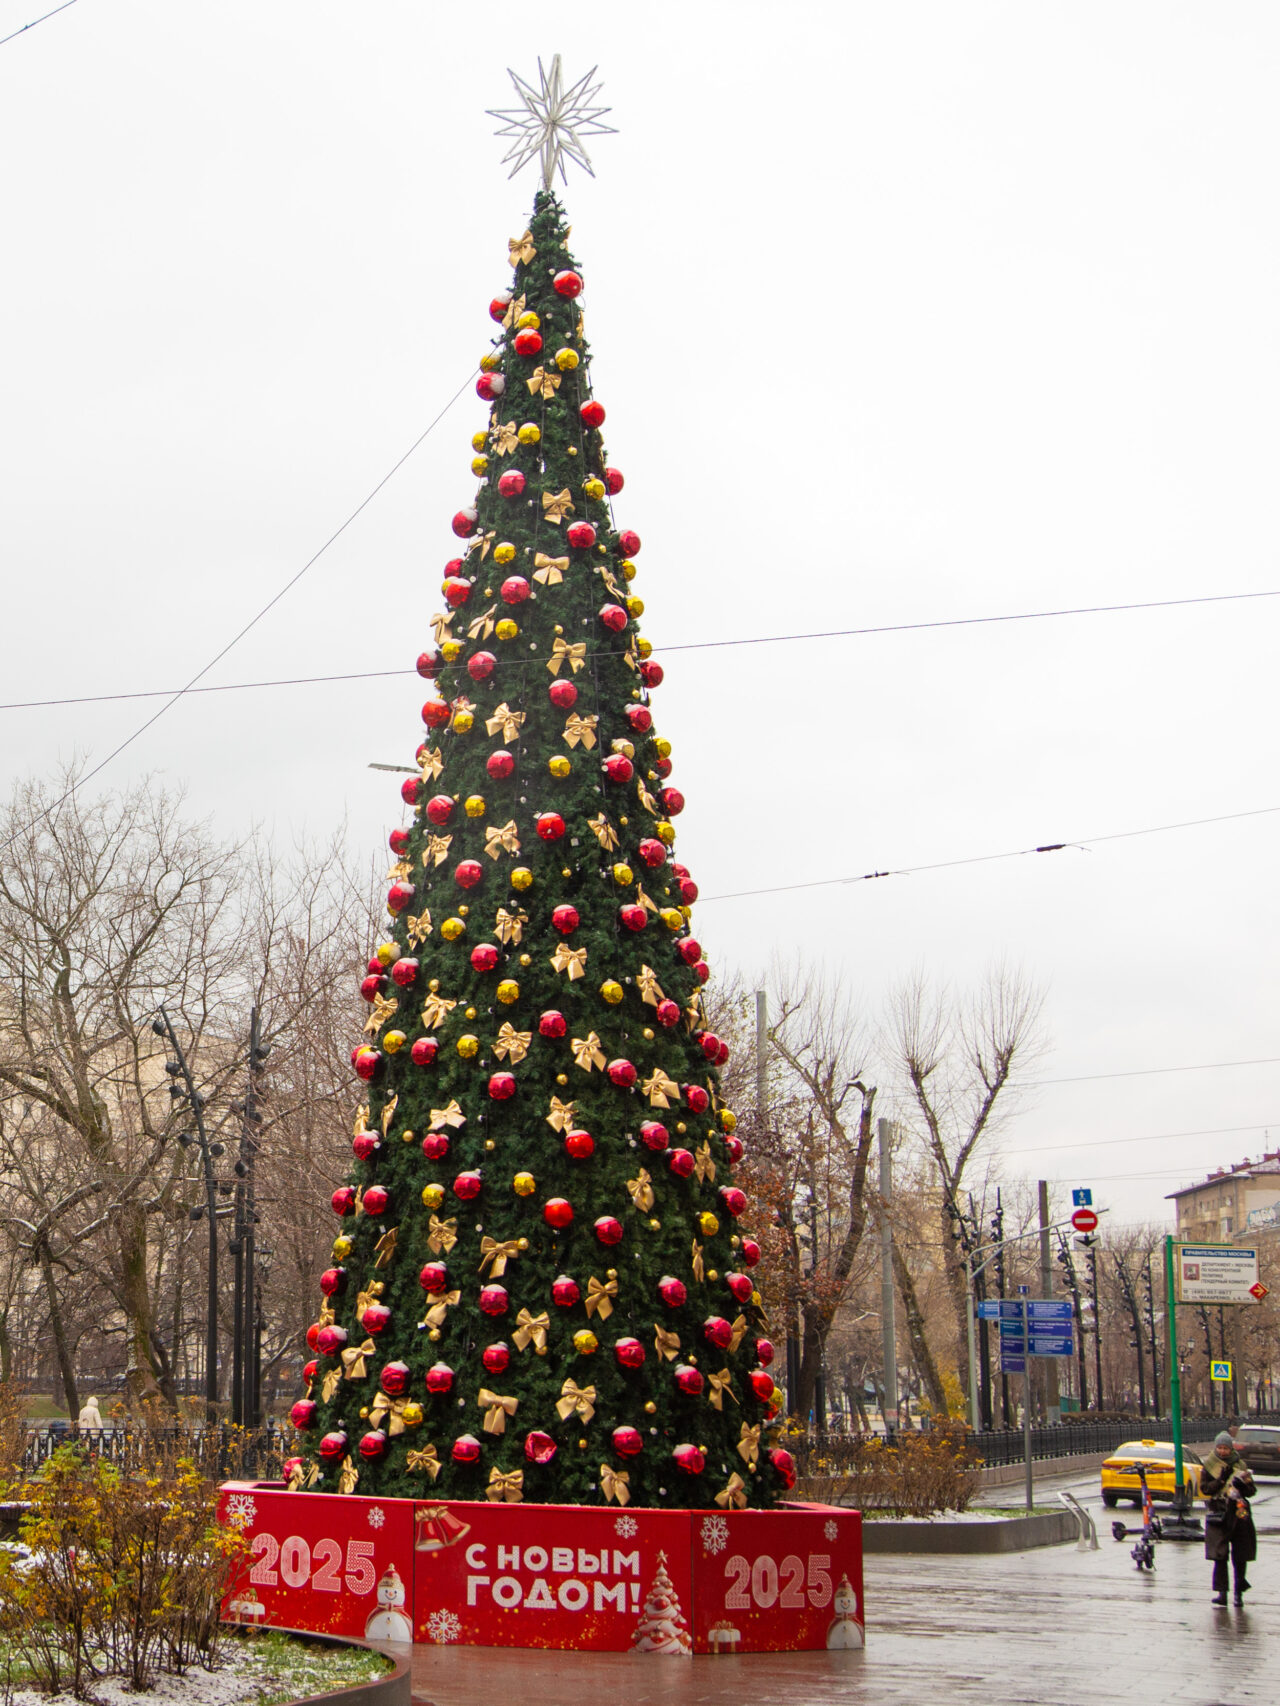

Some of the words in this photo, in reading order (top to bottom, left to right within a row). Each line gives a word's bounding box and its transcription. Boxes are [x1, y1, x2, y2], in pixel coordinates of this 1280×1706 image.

[249, 1532, 376, 1595] 2025
[465, 1543, 487, 1569] С
[497, 1544, 640, 1576] НОВЫМ
[724, 1554, 833, 1609] 2025
[466, 1575, 641, 1614] ГОДОМ!
